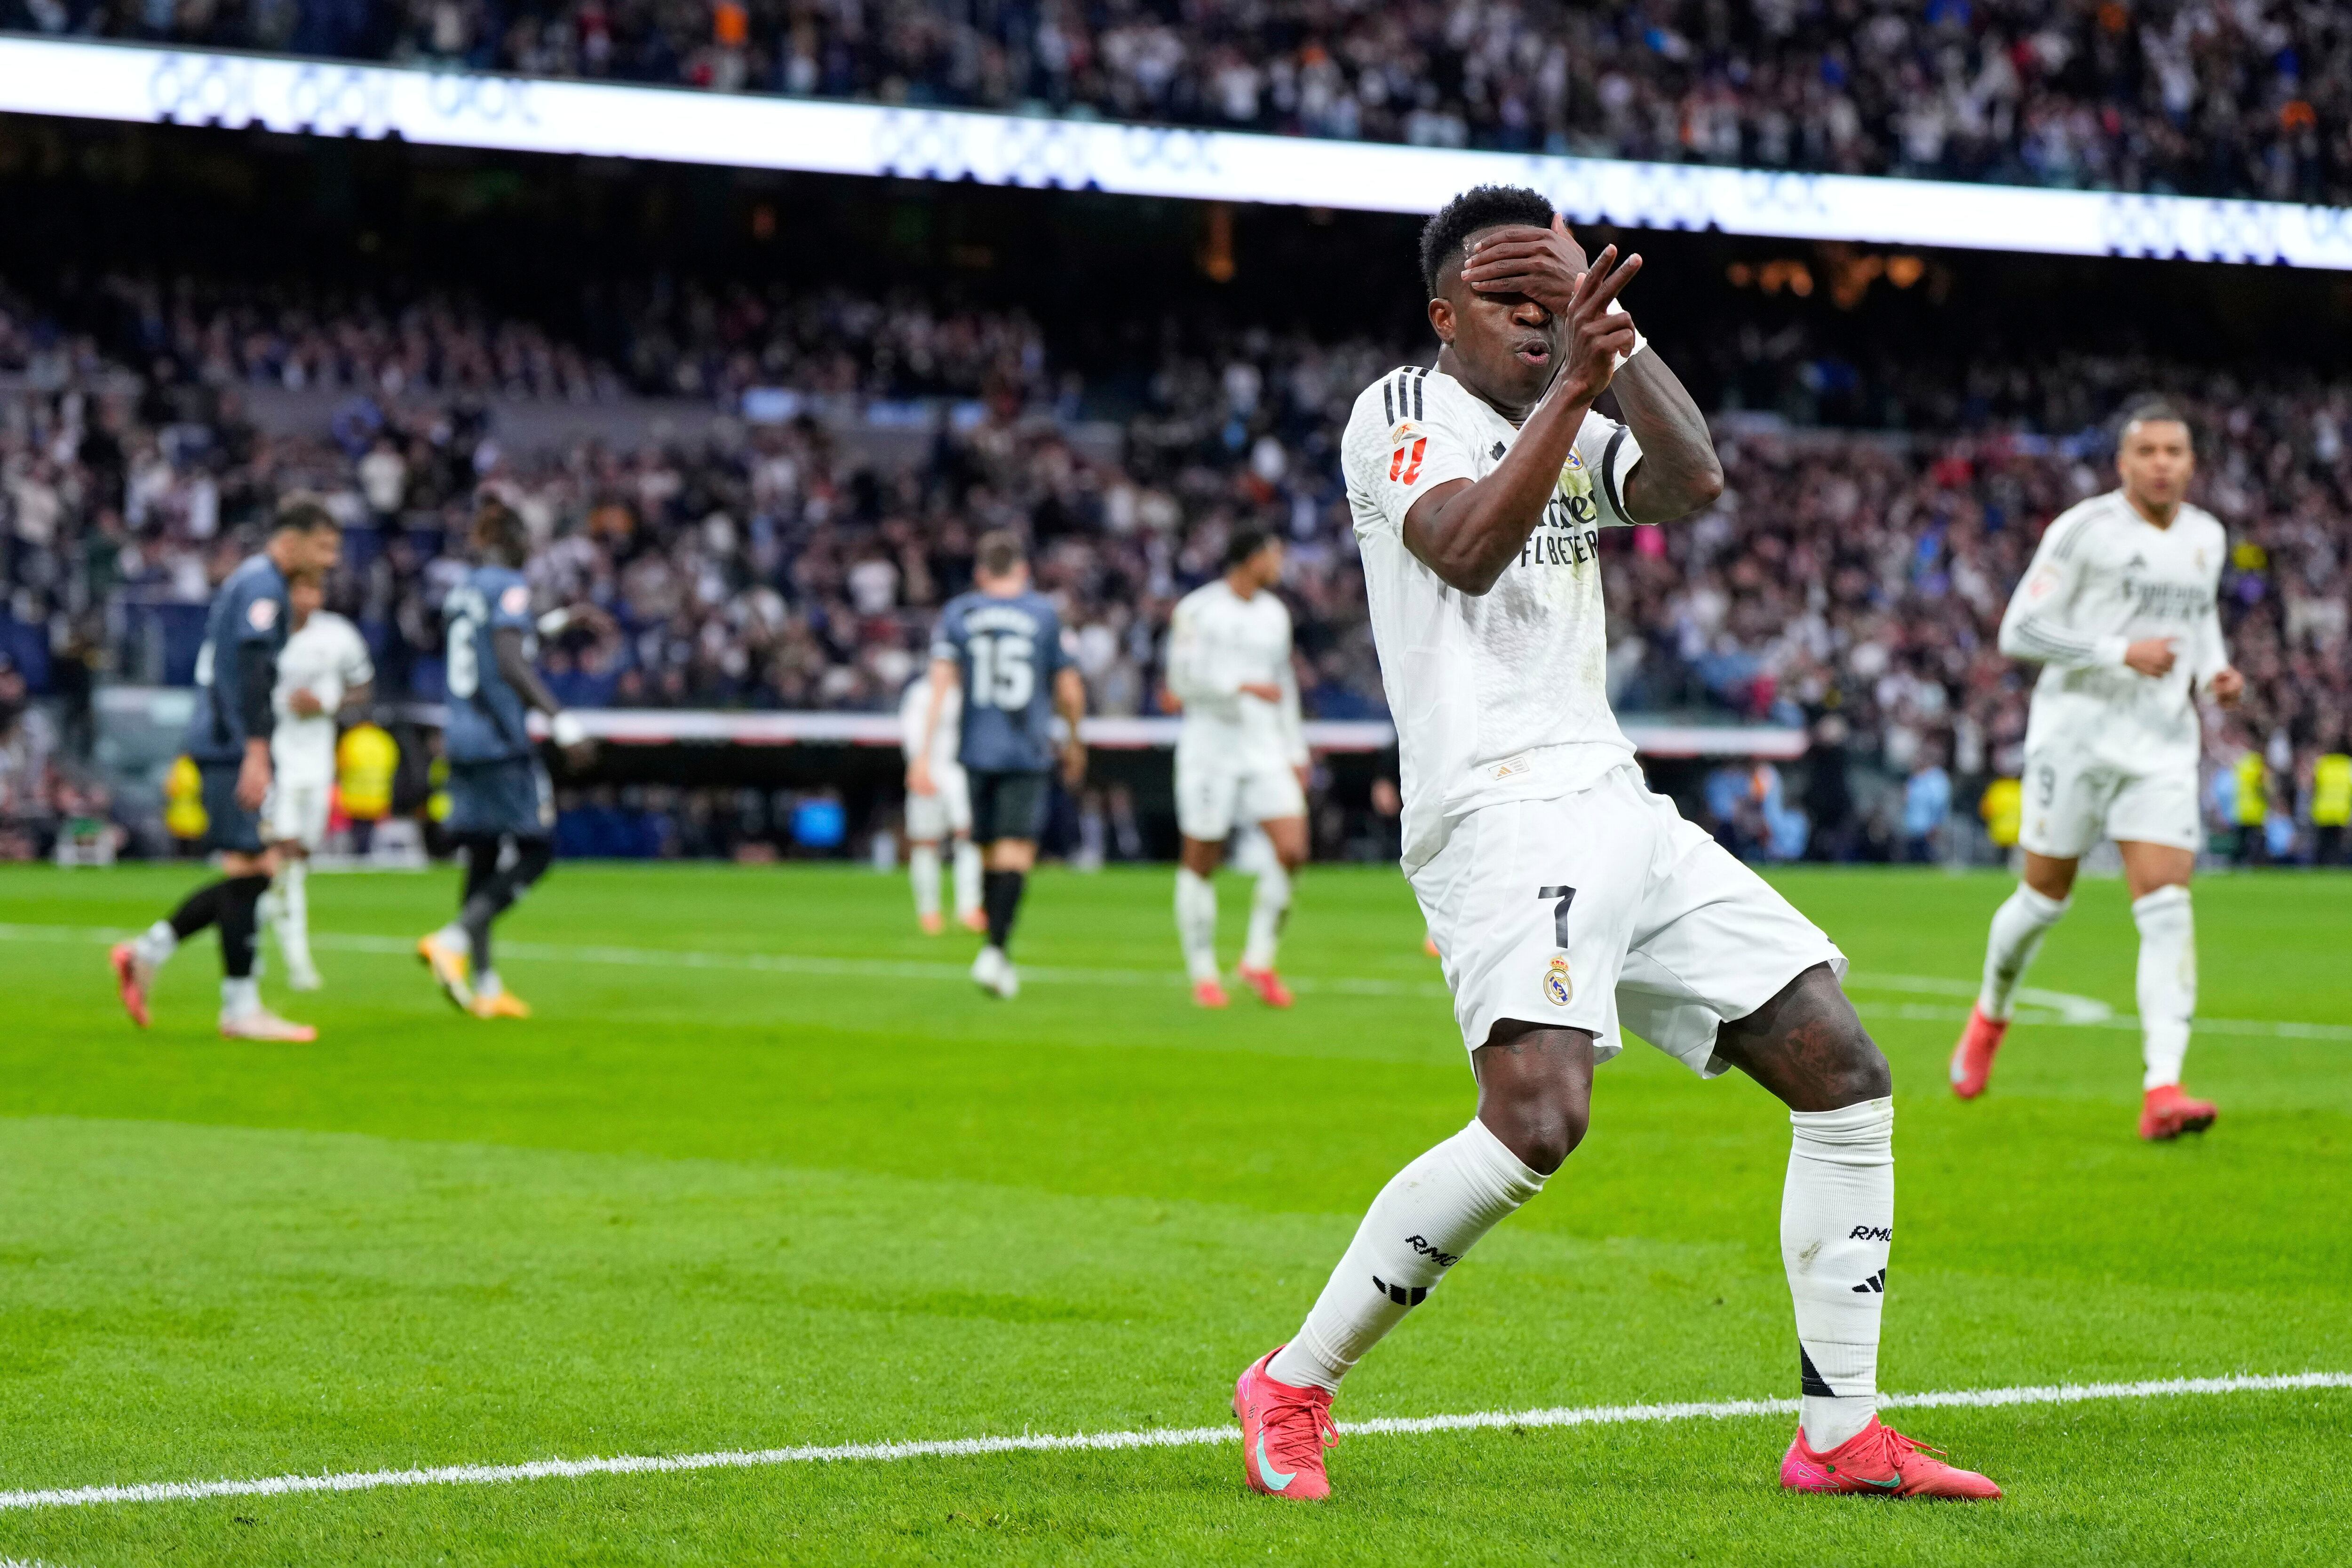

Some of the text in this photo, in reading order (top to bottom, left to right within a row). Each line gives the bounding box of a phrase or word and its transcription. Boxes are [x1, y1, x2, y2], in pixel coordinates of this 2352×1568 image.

[969, 636, 1033, 710] 15
[2038, 764, 2055, 808] 9
[1538, 885, 1576, 949] 7
[1405, 1235, 1463, 1266] RMC
